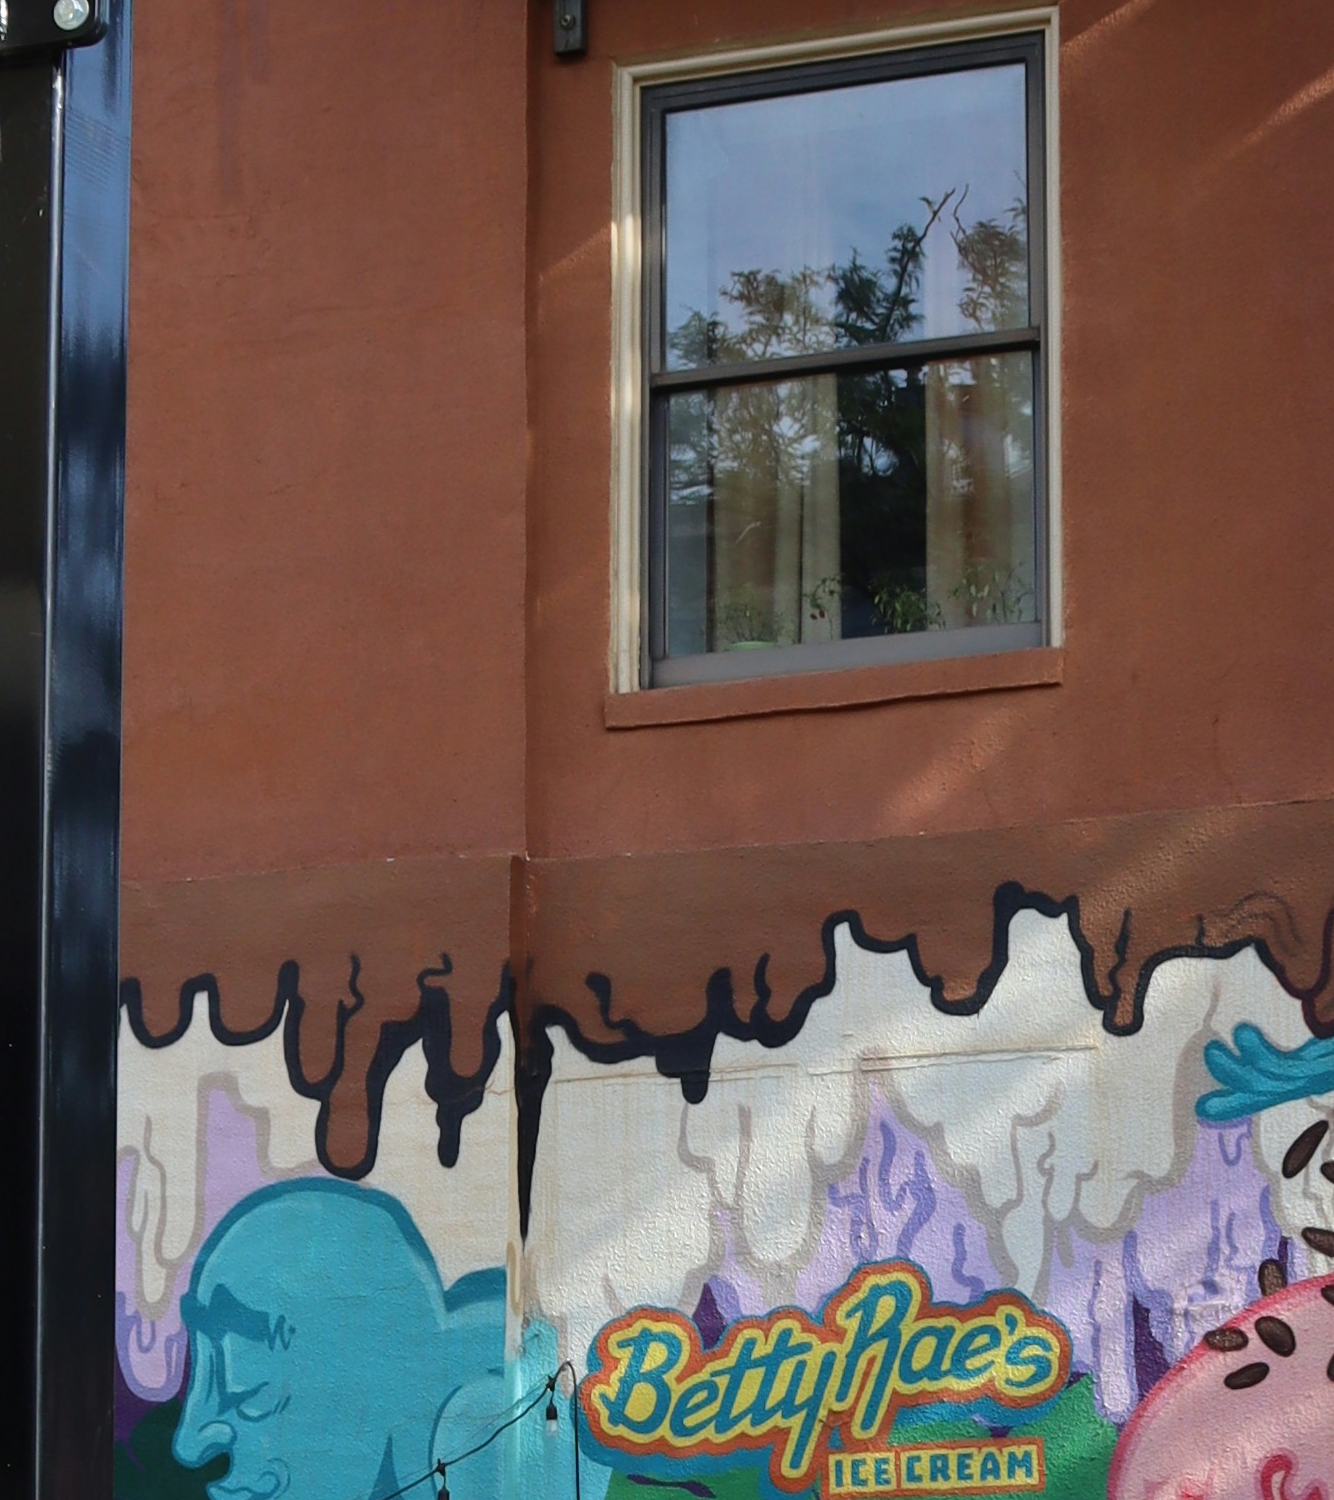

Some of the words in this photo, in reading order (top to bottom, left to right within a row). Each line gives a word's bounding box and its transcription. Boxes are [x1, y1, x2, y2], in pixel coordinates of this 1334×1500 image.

[591, 1324, 839, 1471] Betty
[831, 1277, 1058, 1438] Rae's
[833, 1457, 898, 1489] ICE
[904, 1447, 1035, 1484] CREAM
